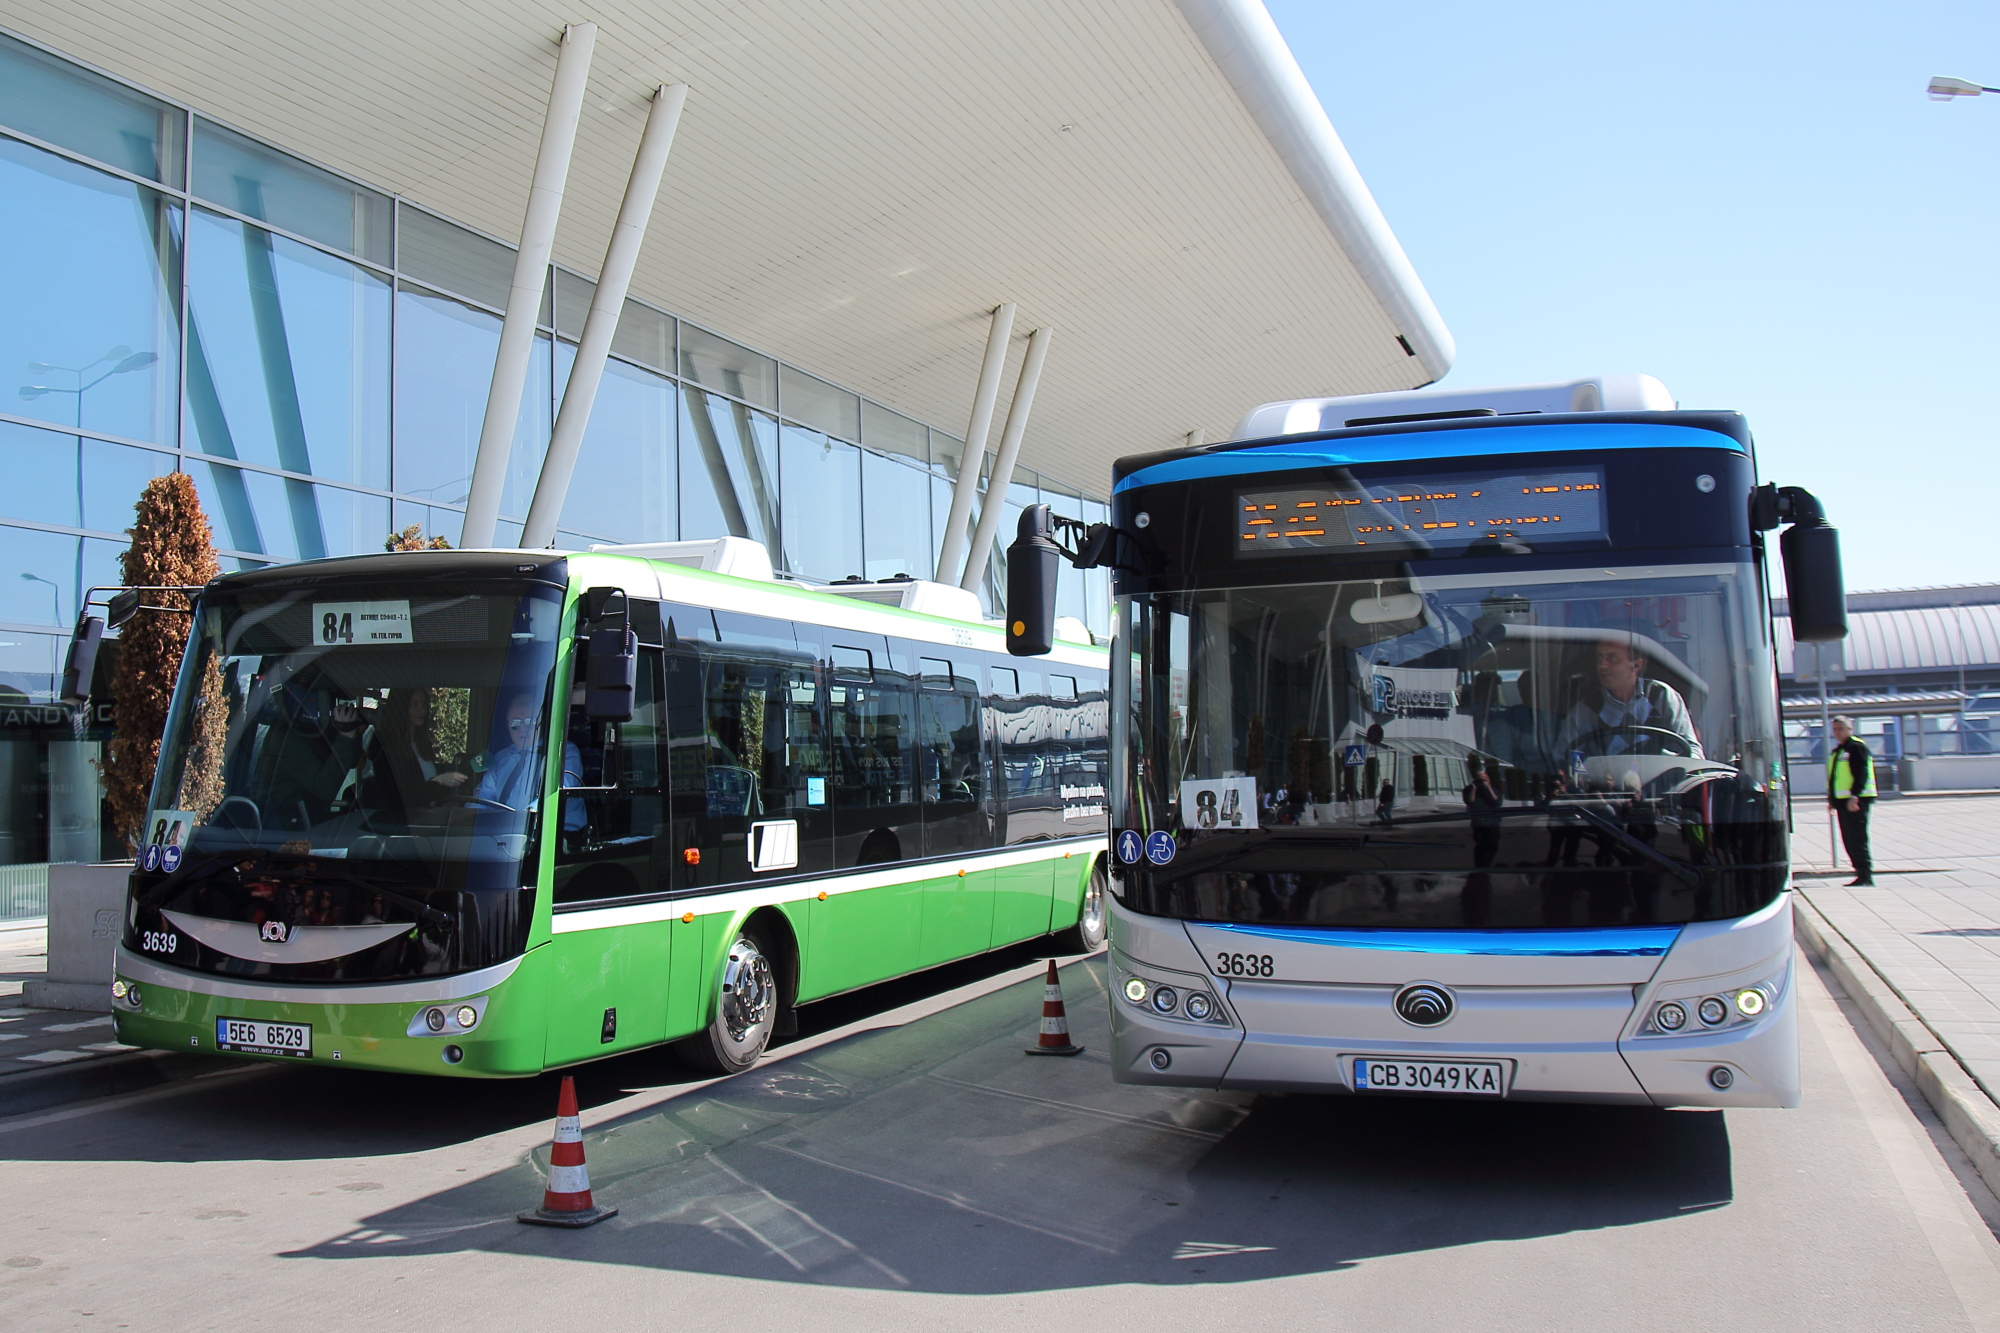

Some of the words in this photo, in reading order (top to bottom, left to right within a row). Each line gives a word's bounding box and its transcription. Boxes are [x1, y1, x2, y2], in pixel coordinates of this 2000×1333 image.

[323, 612, 354, 643] 84
[1196, 789, 1243, 828] 84
[153, 818, 187, 847] 84
[143, 930, 177, 953] 3639
[1216, 951, 1275, 978] 3638
[229, 1022, 256, 1043] 5E6
[267, 1026, 303, 1047] 6529
[241, 1045, 284, 1055] www.sor.cz
[1356, 1077, 1367, 1085] BG
[1370, 1064, 1400, 1086] CB
[1405, 1065, 1461, 1089] 3049
[1465, 1067, 1496, 1091] KA
